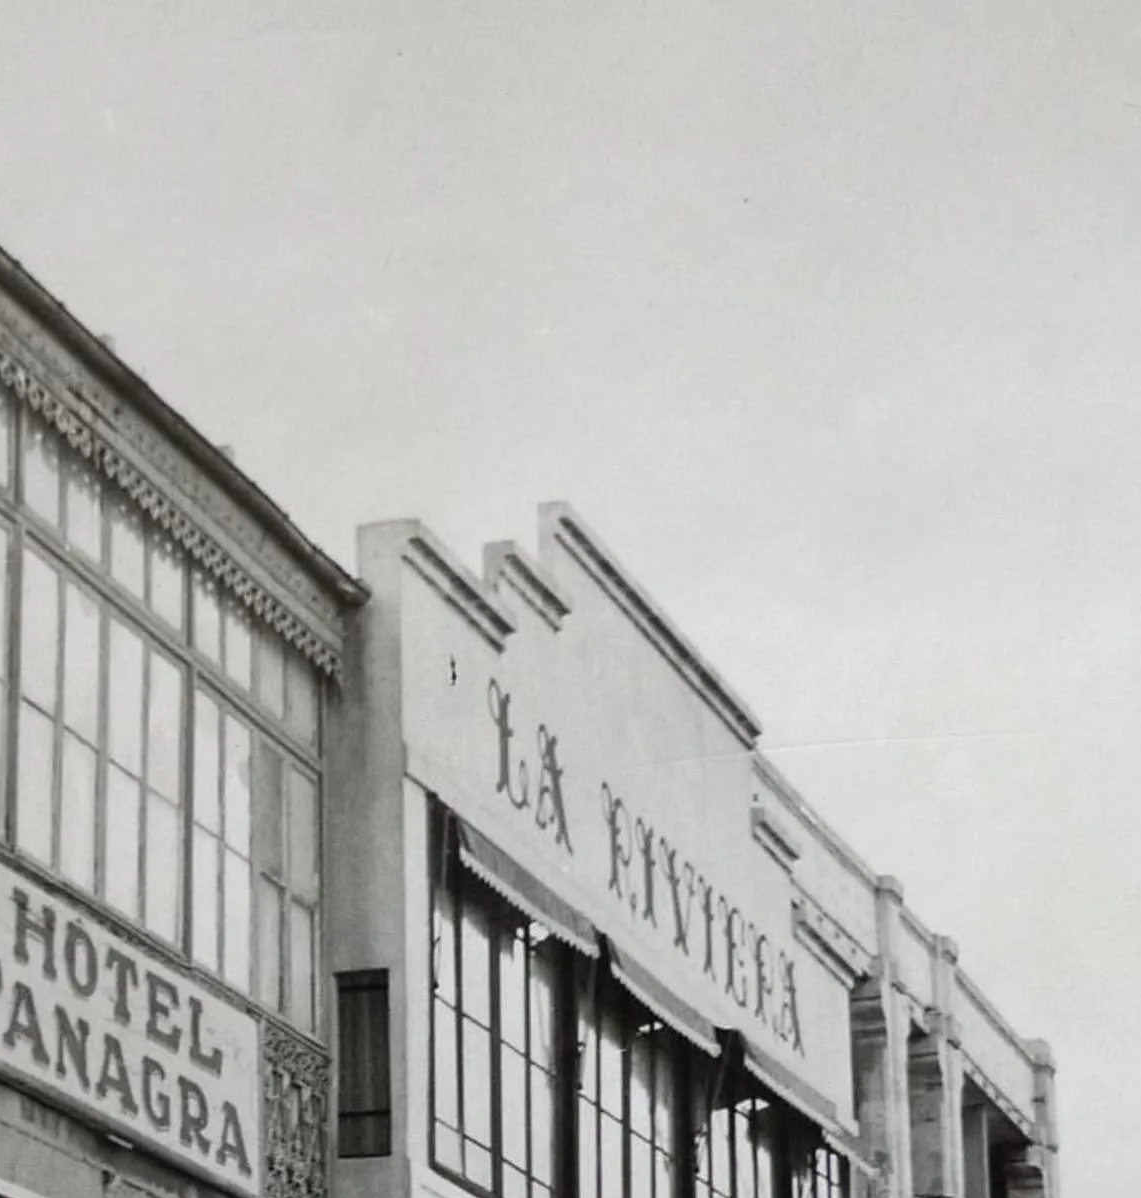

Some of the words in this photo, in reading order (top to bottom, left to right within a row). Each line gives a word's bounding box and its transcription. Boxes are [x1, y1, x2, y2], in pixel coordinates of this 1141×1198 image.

[11, 885, 223, 1079] HOTEL
[487, 676, 574, 858] LA
[600, 781, 805, 1059] RIVIERA
